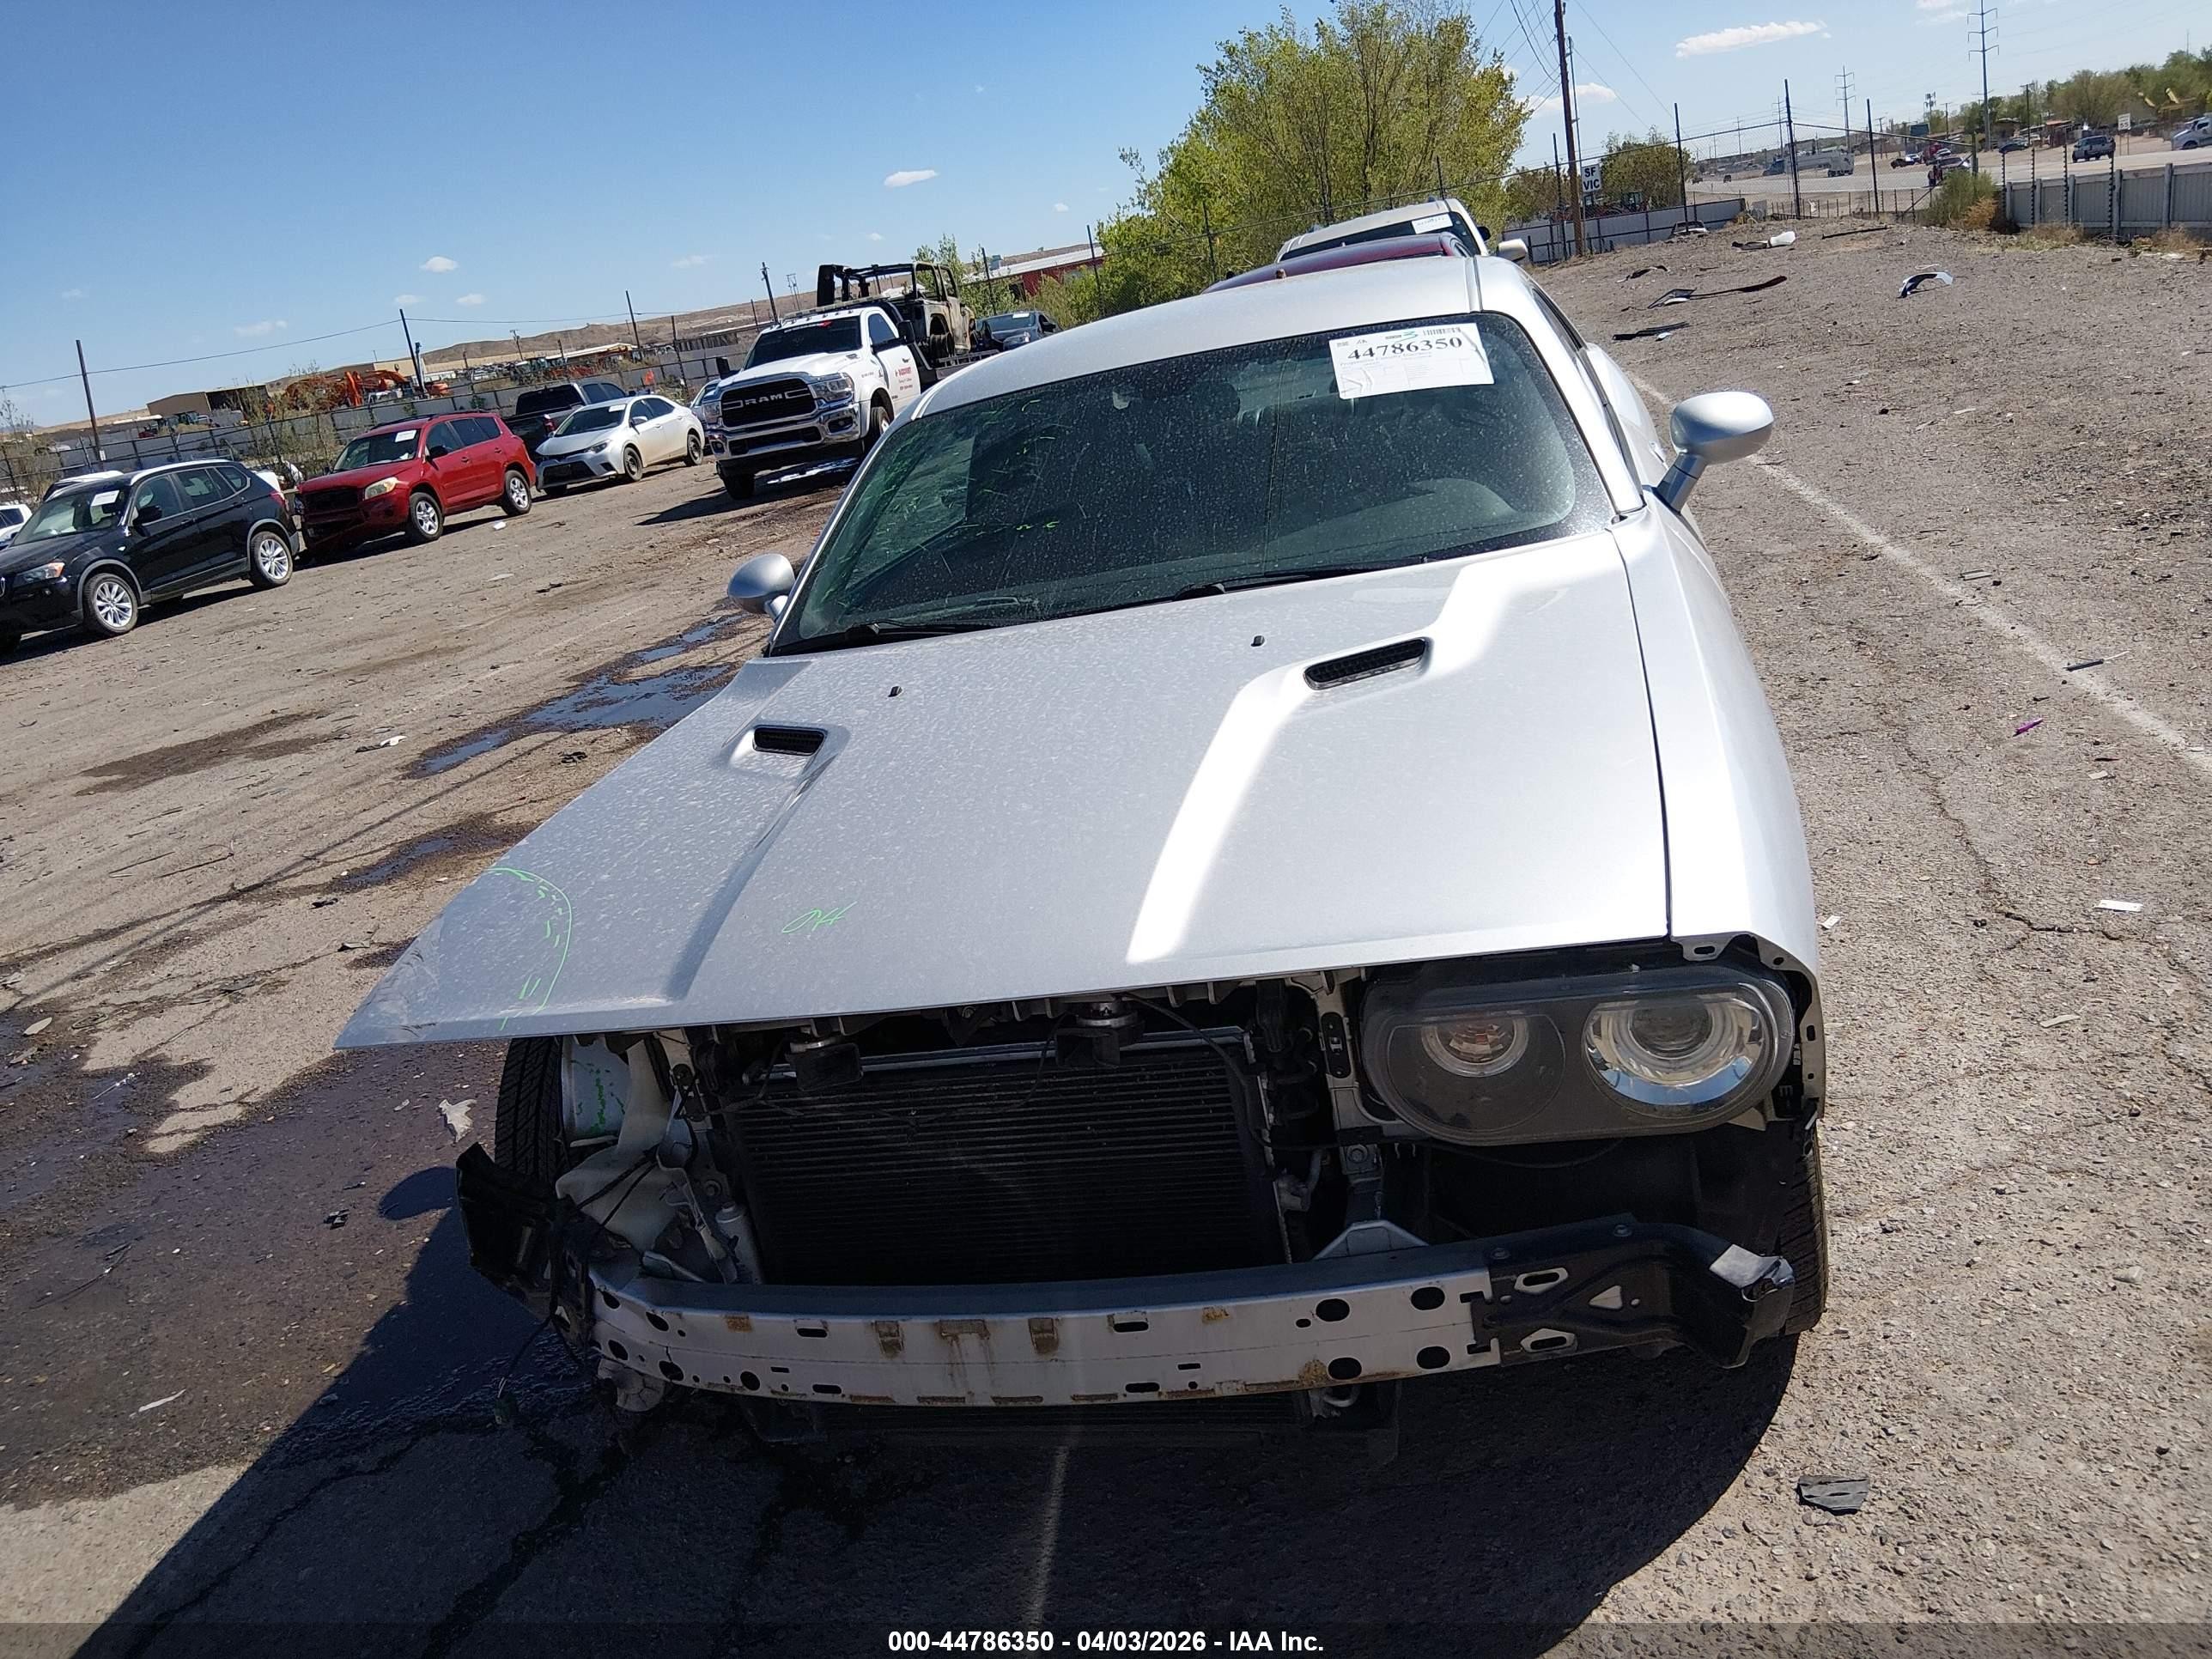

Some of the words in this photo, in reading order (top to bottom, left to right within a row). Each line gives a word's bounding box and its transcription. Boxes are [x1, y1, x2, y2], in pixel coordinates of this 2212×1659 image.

[1584, 167, 1596, 178] SF
[1583, 179, 1600, 191] VIC
[1347, 337, 1463, 361] 44786350
[744, 393, 783, 406] RAM
